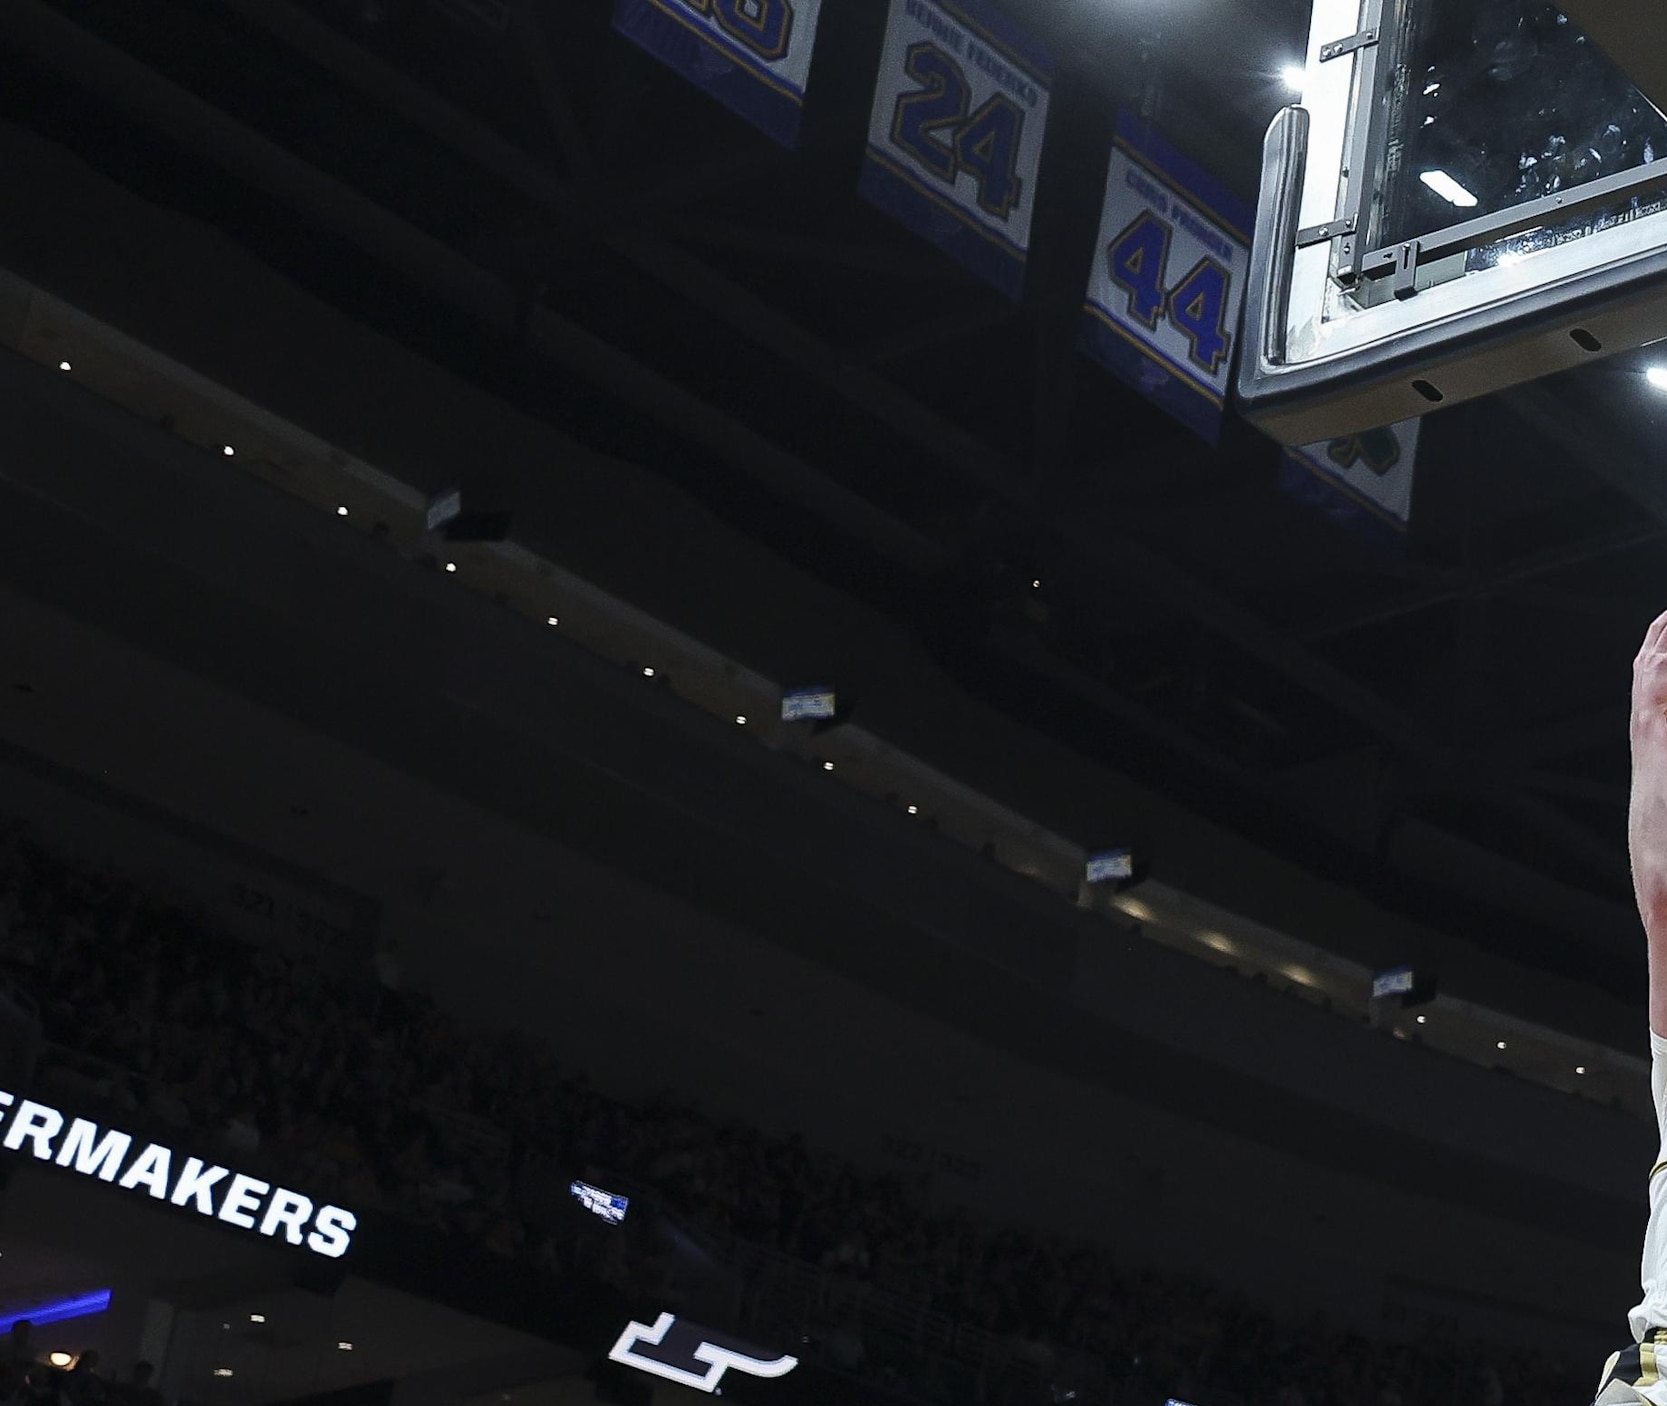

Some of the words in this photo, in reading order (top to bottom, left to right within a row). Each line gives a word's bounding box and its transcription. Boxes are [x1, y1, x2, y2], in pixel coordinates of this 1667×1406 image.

[890, 40, 1026, 222] 24
[1107, 209, 1231, 374] 44
[0, 1091, 358, 1258] RMAKERS
